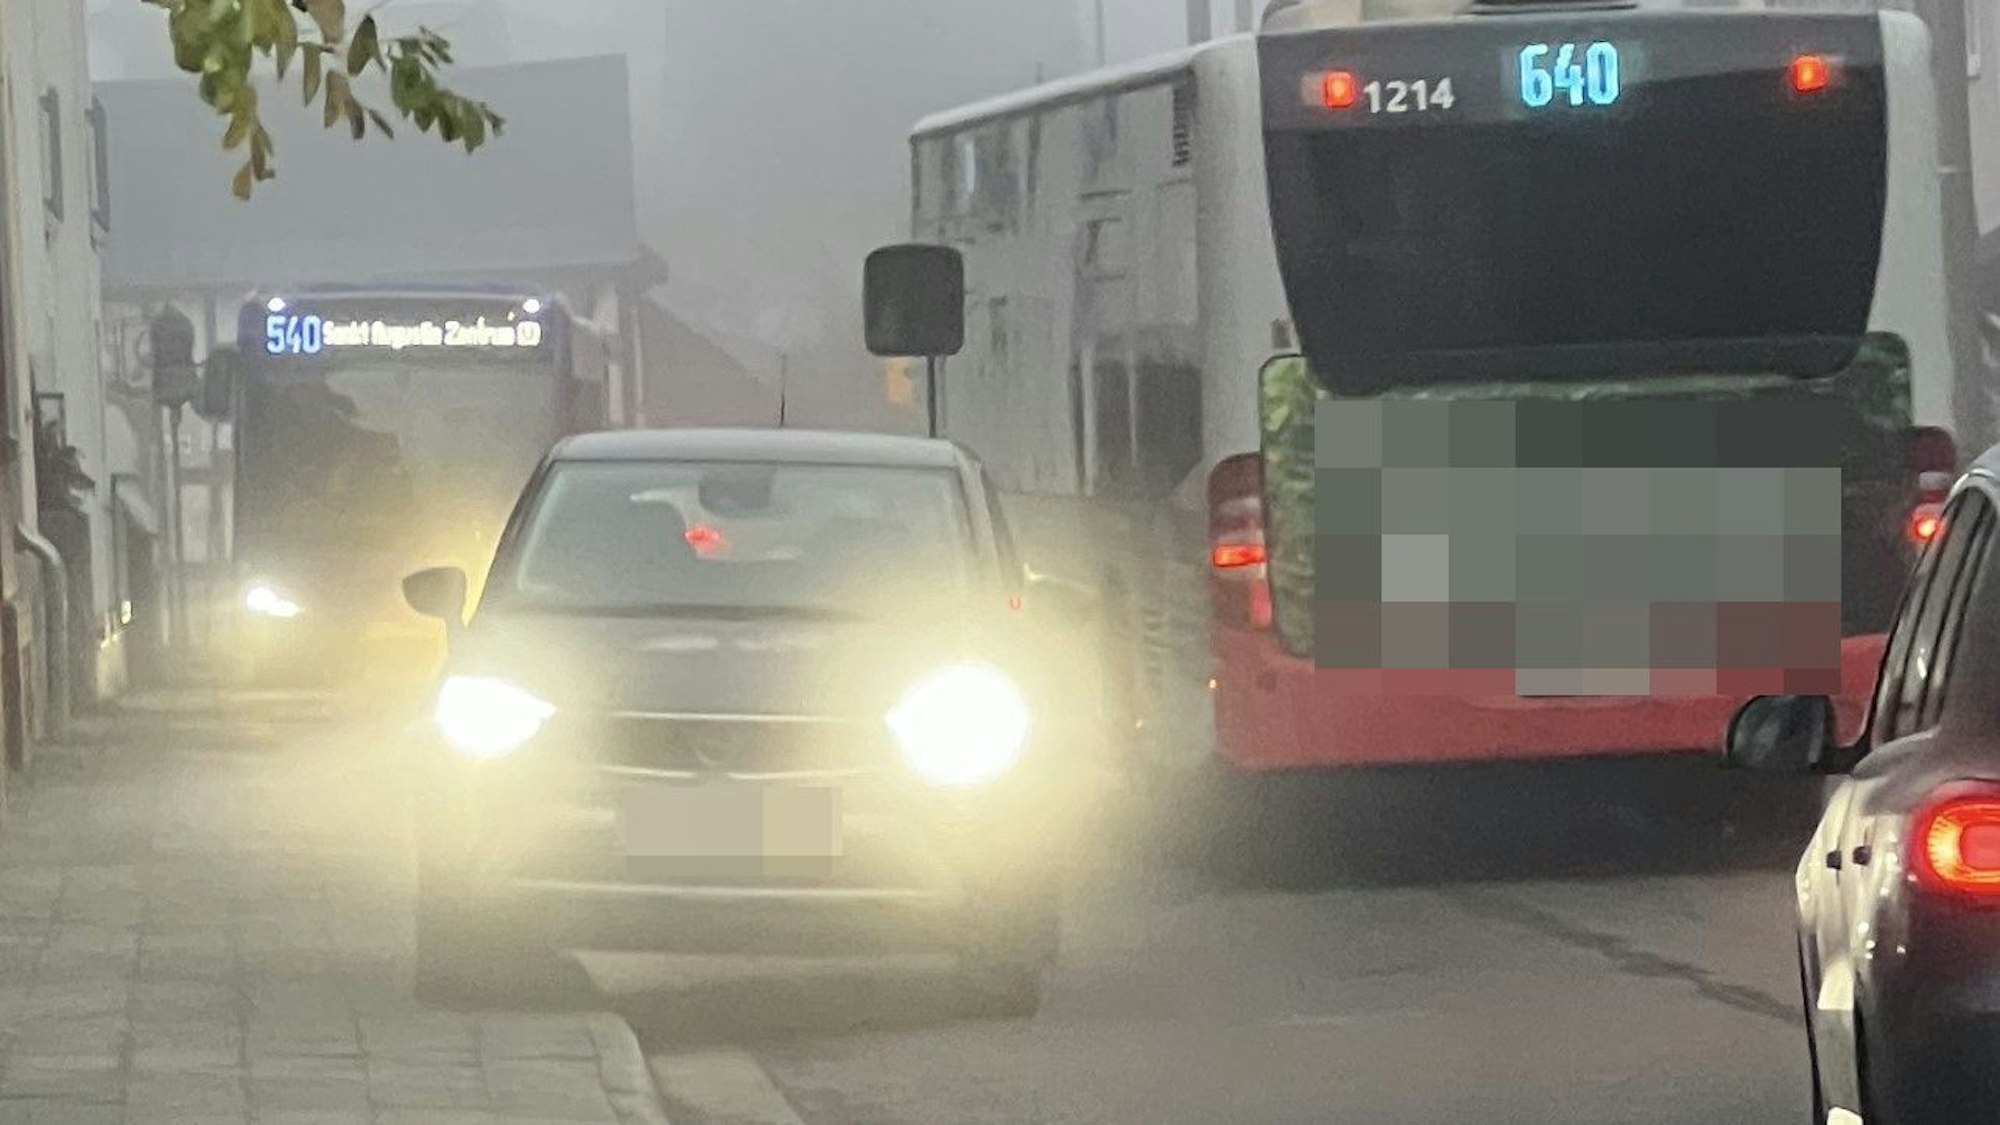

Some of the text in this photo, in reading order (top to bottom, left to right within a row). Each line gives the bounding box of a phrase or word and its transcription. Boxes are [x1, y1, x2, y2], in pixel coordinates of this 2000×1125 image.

[1519, 41, 1620, 107] 640
[1363, 77, 1455, 114] 1214
[266, 315, 321, 354] 540
